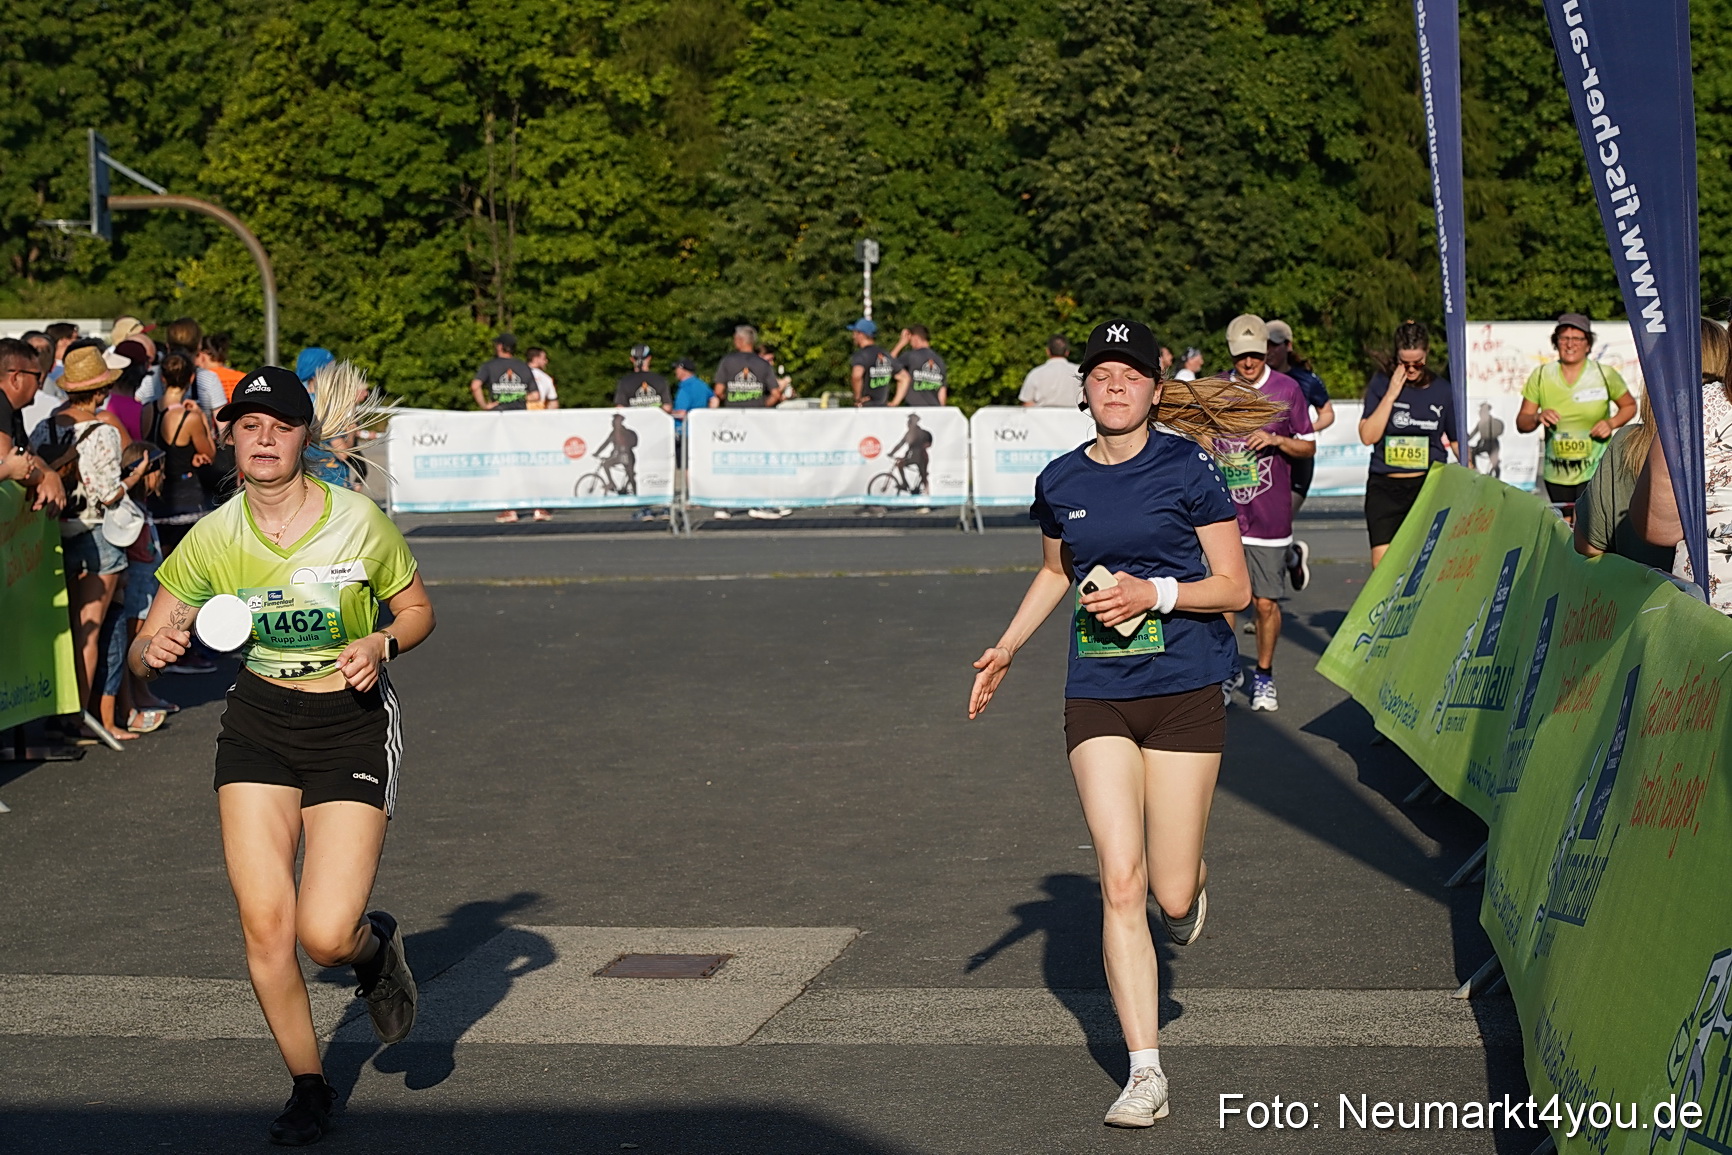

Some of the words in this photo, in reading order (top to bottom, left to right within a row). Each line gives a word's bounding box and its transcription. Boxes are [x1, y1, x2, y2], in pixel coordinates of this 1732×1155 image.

[1106, 324, 1130, 342] NY
[245, 385, 272, 394] adidas
[412, 434, 448, 446] NOW
[712, 430, 747, 442] NOW
[994, 429, 1028, 441] NOW
[1393, 447, 1421, 458] 1785
[1560, 441, 1585, 452] 1509
[415, 456, 468, 469] E-BIKES
[471, 455, 481, 467] &
[714, 454, 767, 466] E-BIKES
[264, 598, 294, 607] Firmenlauf
[258, 609, 327, 635] 1462
[326, 611, 341, 640] 2022
[1081, 618, 1089, 644] RUN
[271, 636, 295, 645] Rupp
[298, 633, 320, 643] Julia
[353, 773, 378, 784] adidas
